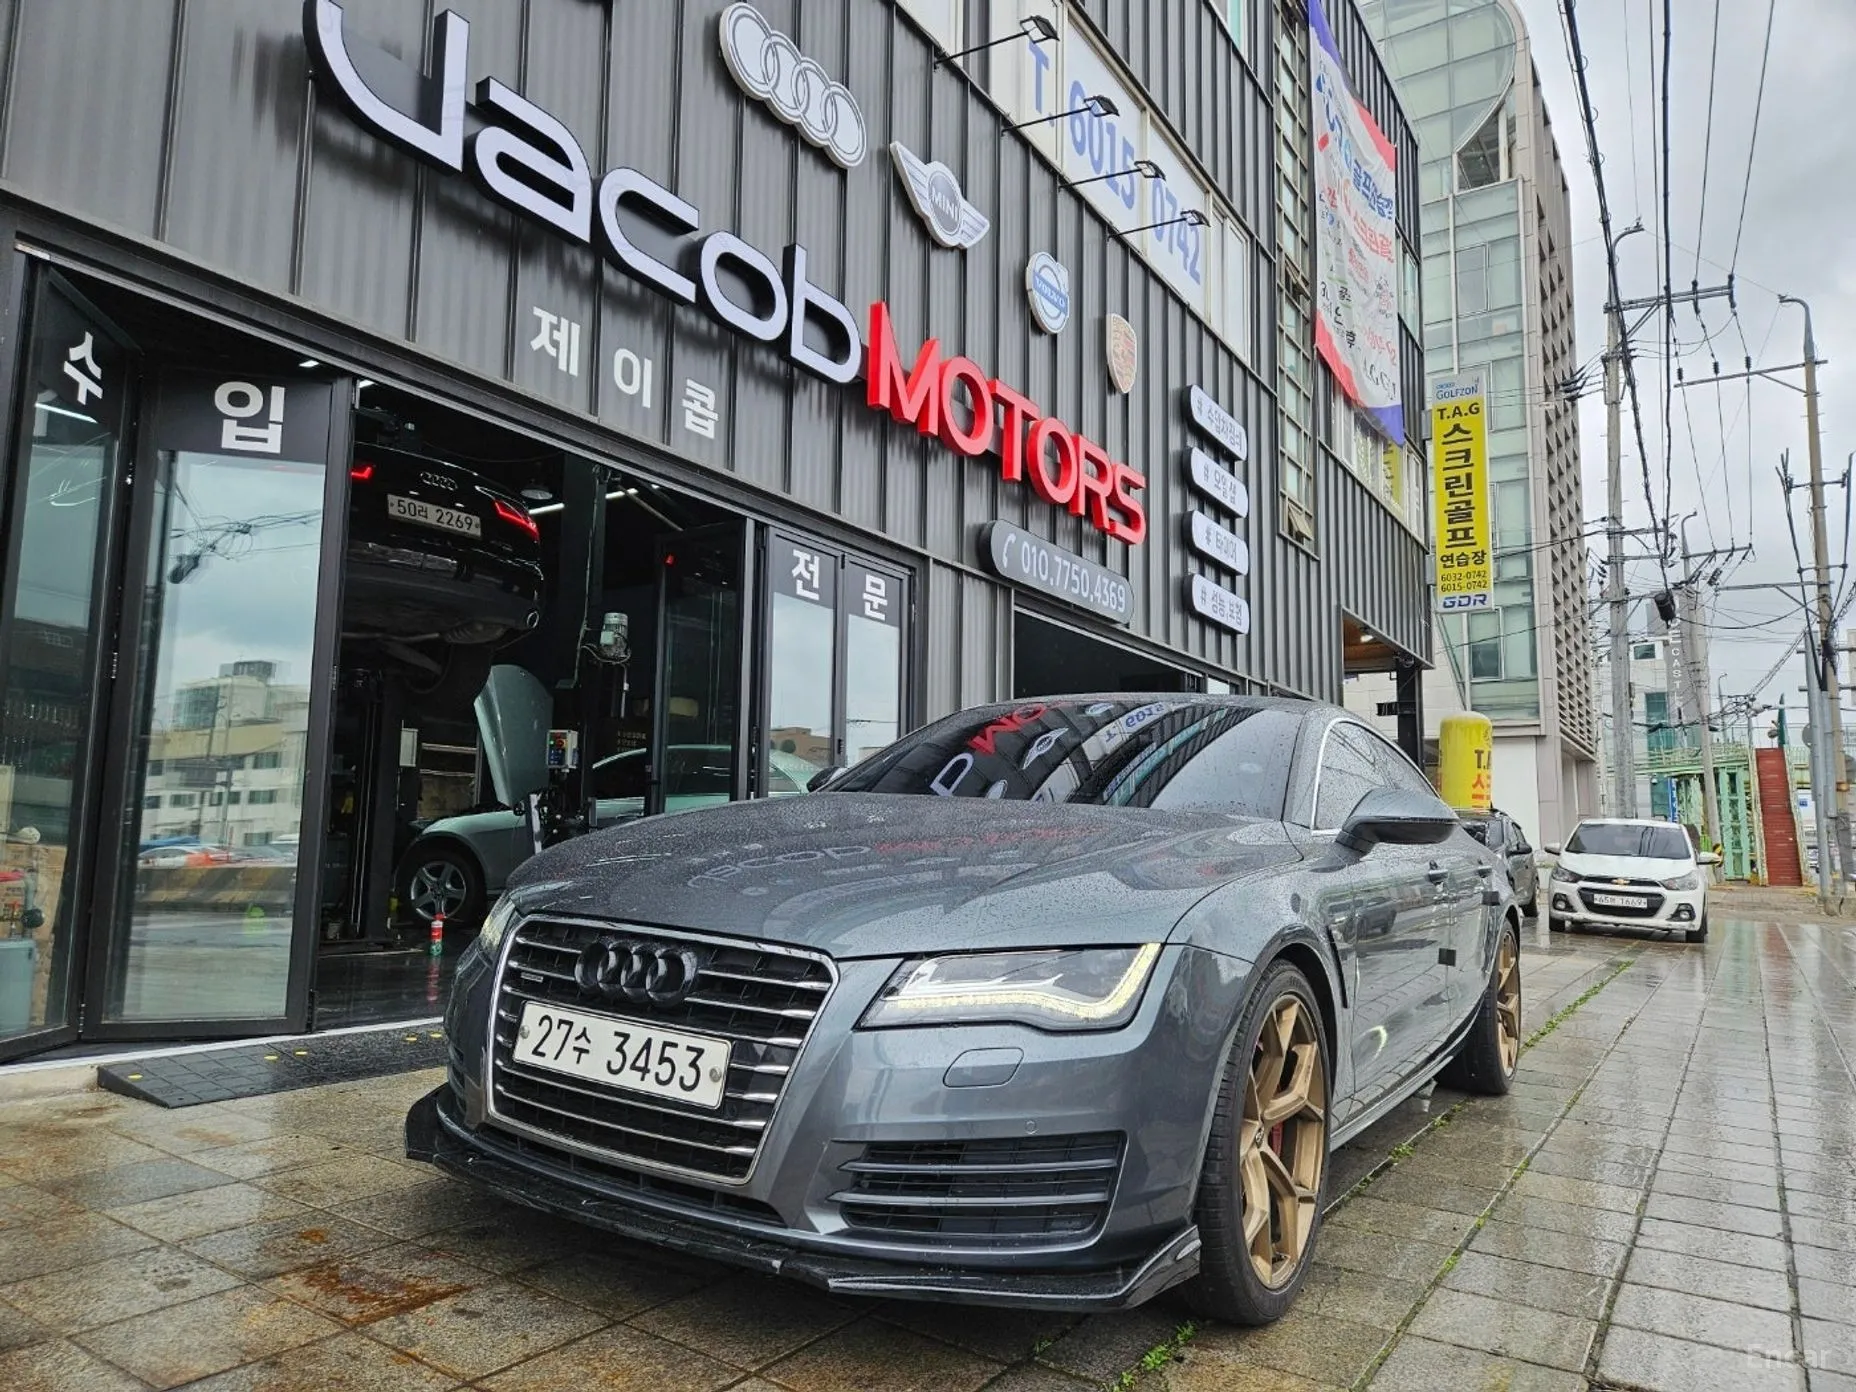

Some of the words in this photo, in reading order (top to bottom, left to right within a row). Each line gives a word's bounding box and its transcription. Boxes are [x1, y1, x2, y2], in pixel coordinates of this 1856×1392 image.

[1068, 79, 1135, 211] 6015
[1152, 176, 1200, 286] 0742
[931, 185, 959, 223] MINI
[1034, 275, 1066, 309] VOLVO
[1436, 386, 1478, 400] GOLFZON
[1437, 402, 1480, 420] T.A.G
[868, 301, 1147, 545] MOTORS
[436, 508, 473, 531] 2269
[1440, 549, 1487, 569] 연습장
[1021, 540, 1126, 613] 010.7750.4369
[1441, 570, 1487, 583] 6032-0742
[1441, 580, 1488, 593] 6015-0742
[1443, 594, 1487, 609] GDR
[531, 1014, 592, 1065] 27수
[606, 1030, 705, 1092] 3453
